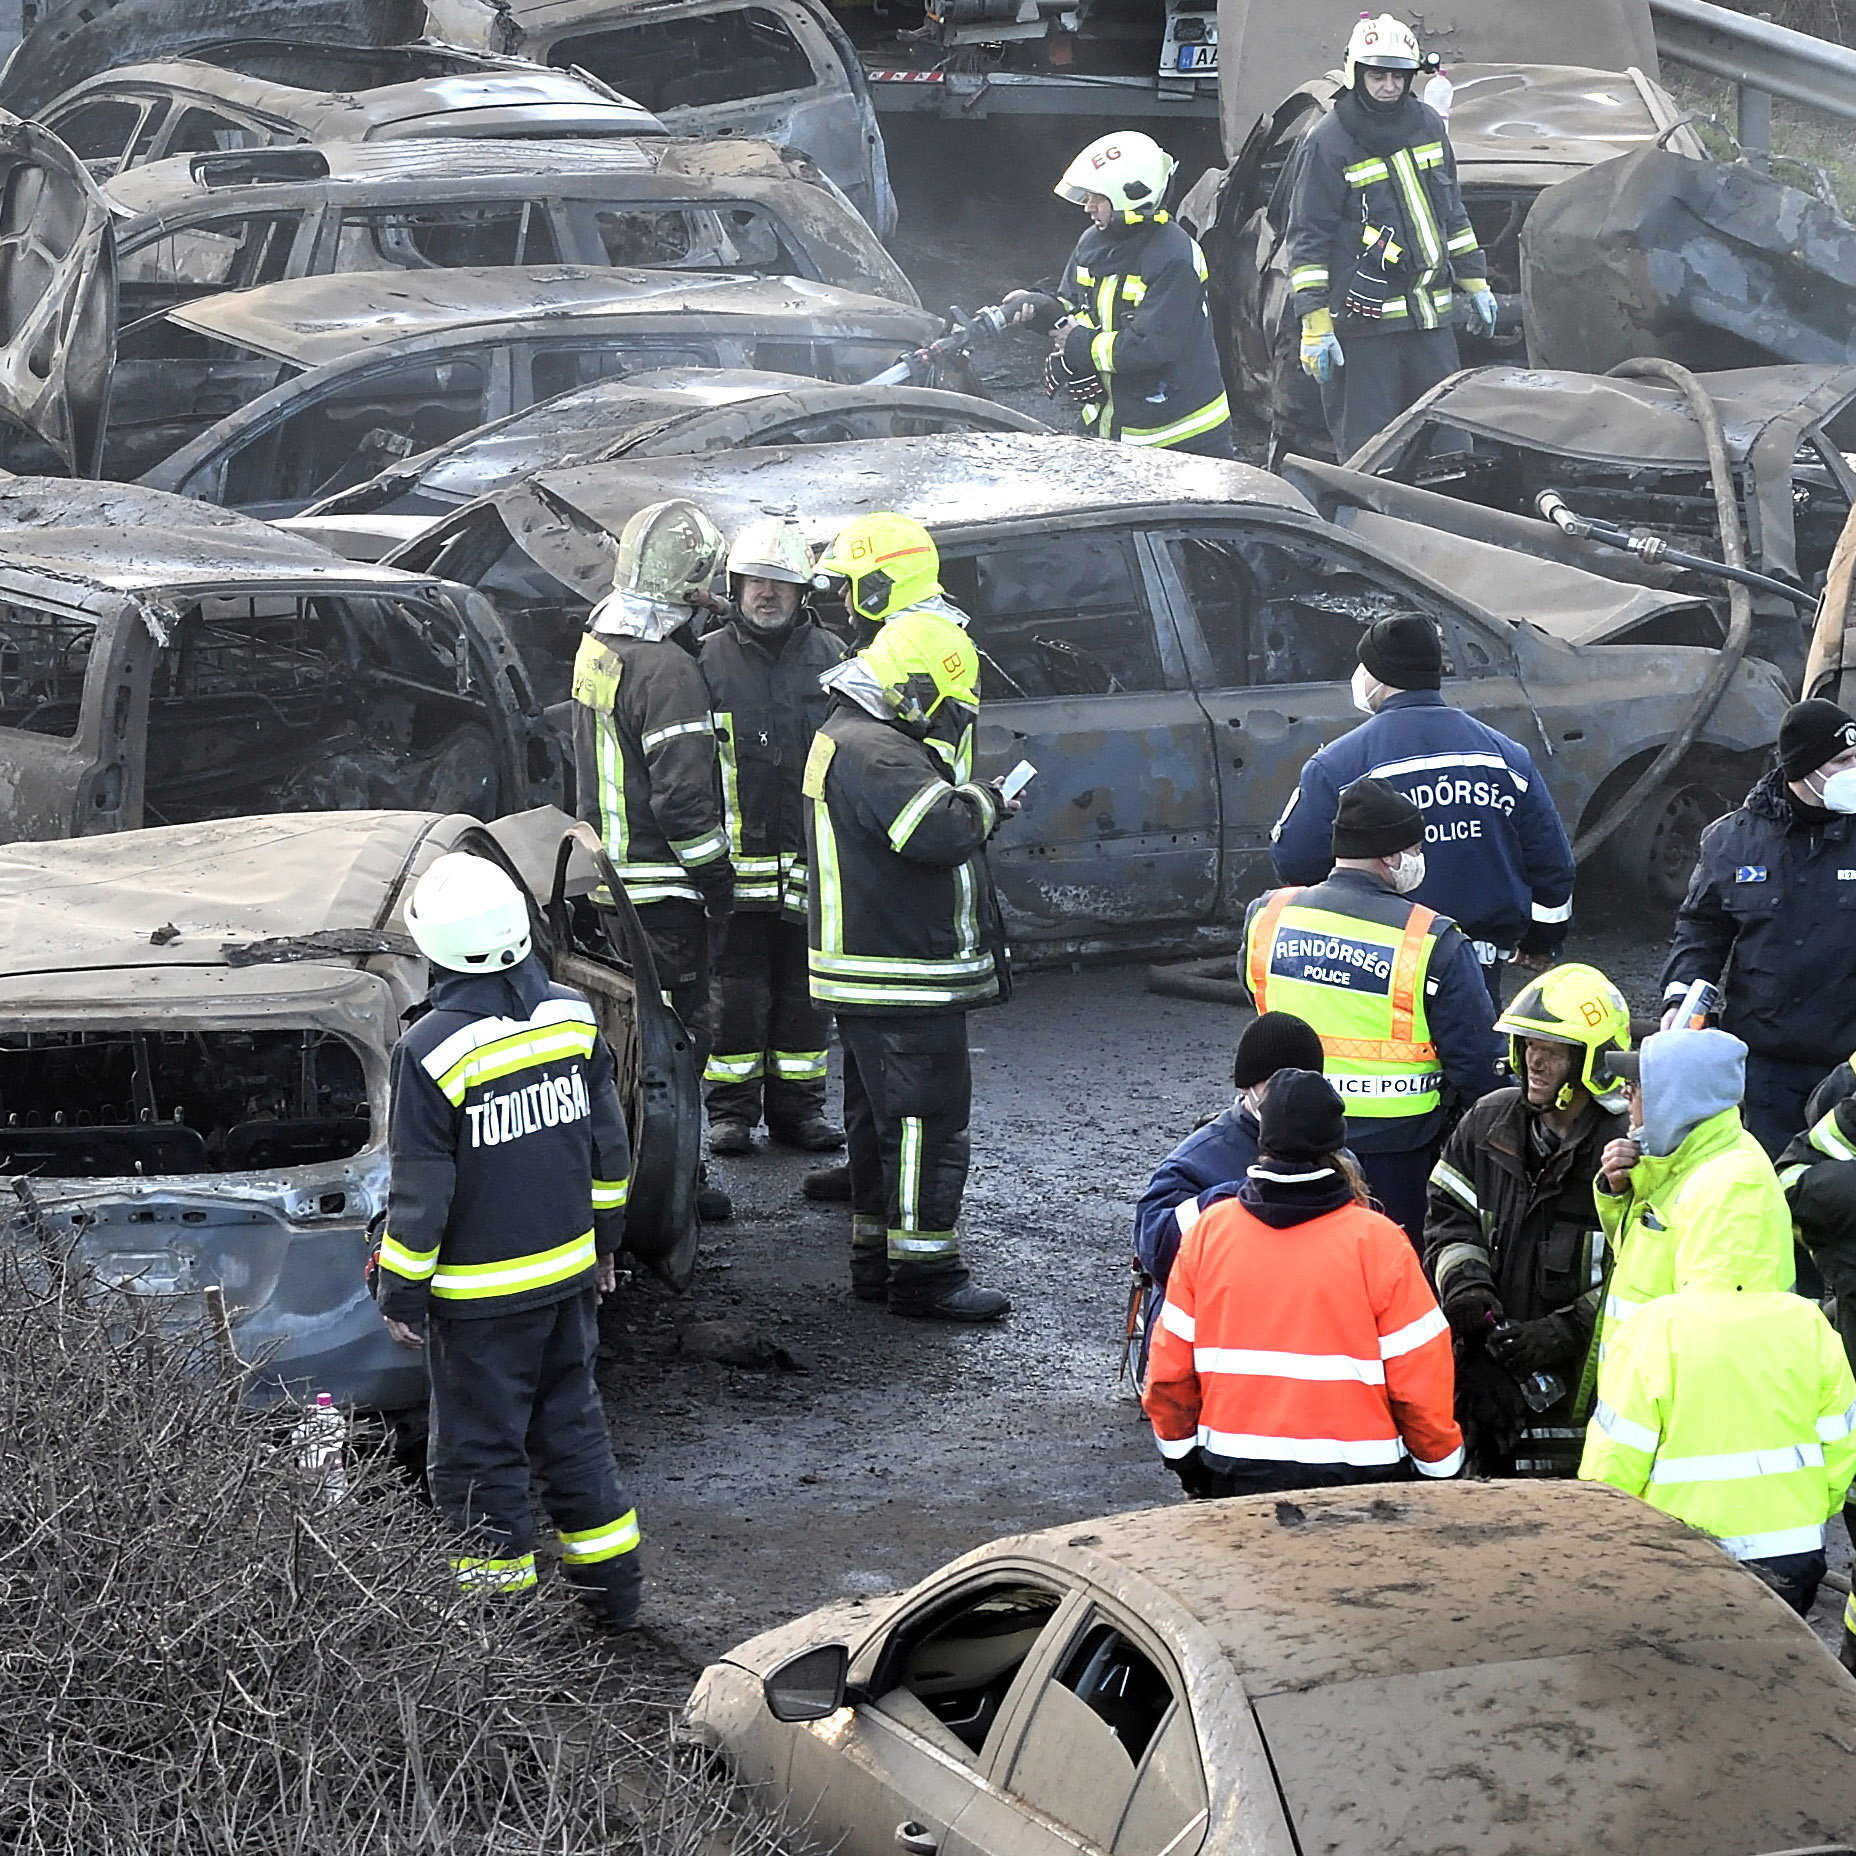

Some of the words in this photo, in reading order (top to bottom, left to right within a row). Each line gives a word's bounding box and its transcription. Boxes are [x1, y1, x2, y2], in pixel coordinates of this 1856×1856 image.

[1090, 146, 1122, 170] EG
[851, 536, 873, 561] BI
[942, 652, 966, 681] BI
[1401, 774, 1516, 817] NDŐRSÉG
[1424, 820, 1483, 843] OLICE
[1276, 938, 1391, 980] RENDŐRSÉG
[1303, 965, 1351, 986] POLICE
[1580, 997, 1609, 1027] BI
[465, 1064, 591, 1149] TŰZOLTÓSÁ
